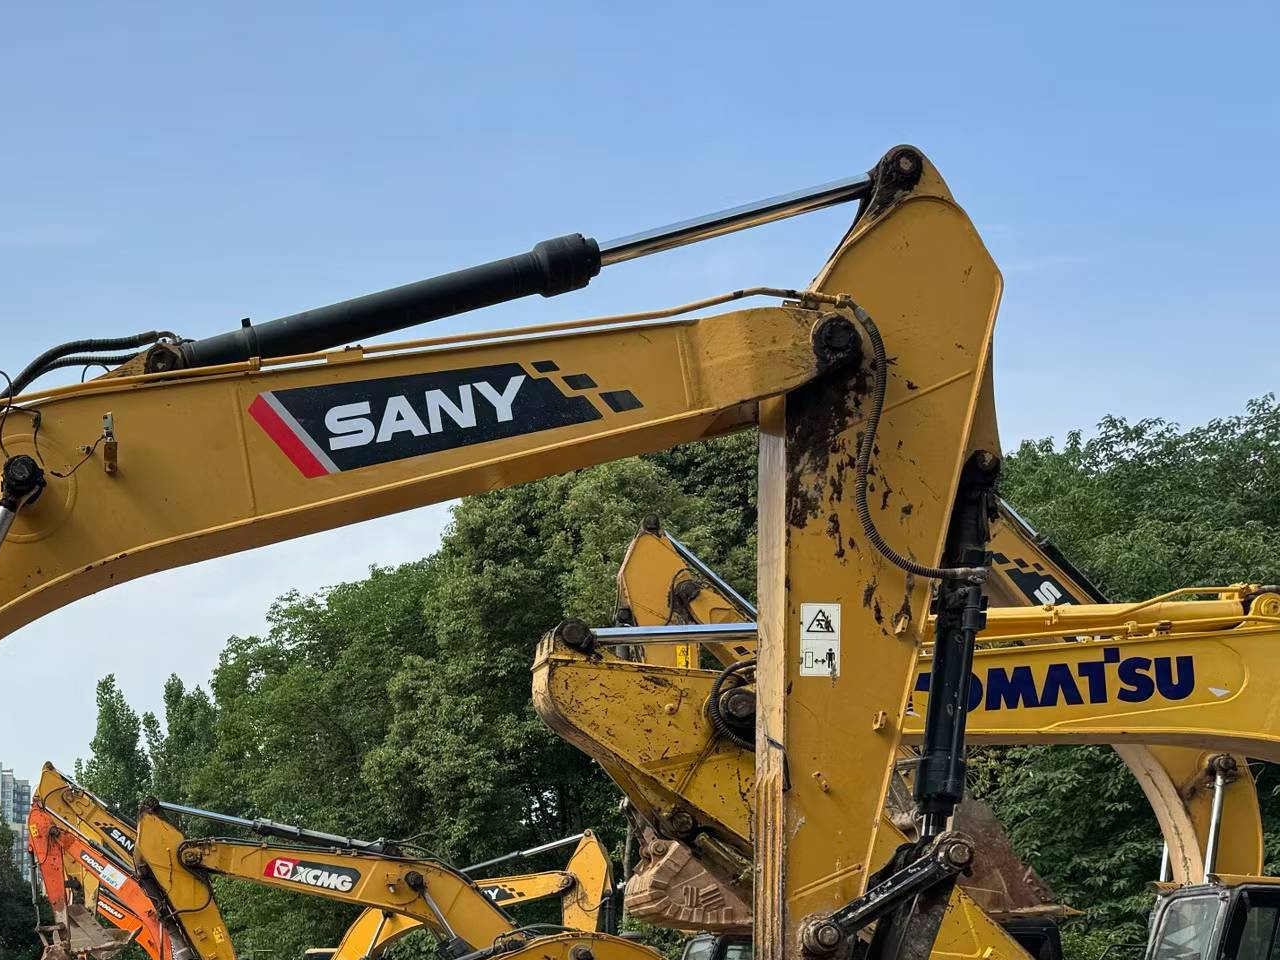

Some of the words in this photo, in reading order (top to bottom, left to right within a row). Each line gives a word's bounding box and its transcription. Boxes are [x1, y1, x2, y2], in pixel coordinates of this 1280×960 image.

[324, 375, 526, 450] SANY
[915, 648, 1195, 712] MATSU
[110, 828, 135, 851] SAN
[81, 853, 104, 873] DOOS
[291, 865, 353, 892] XCMG
[97, 900, 123, 919] DOOSAN
